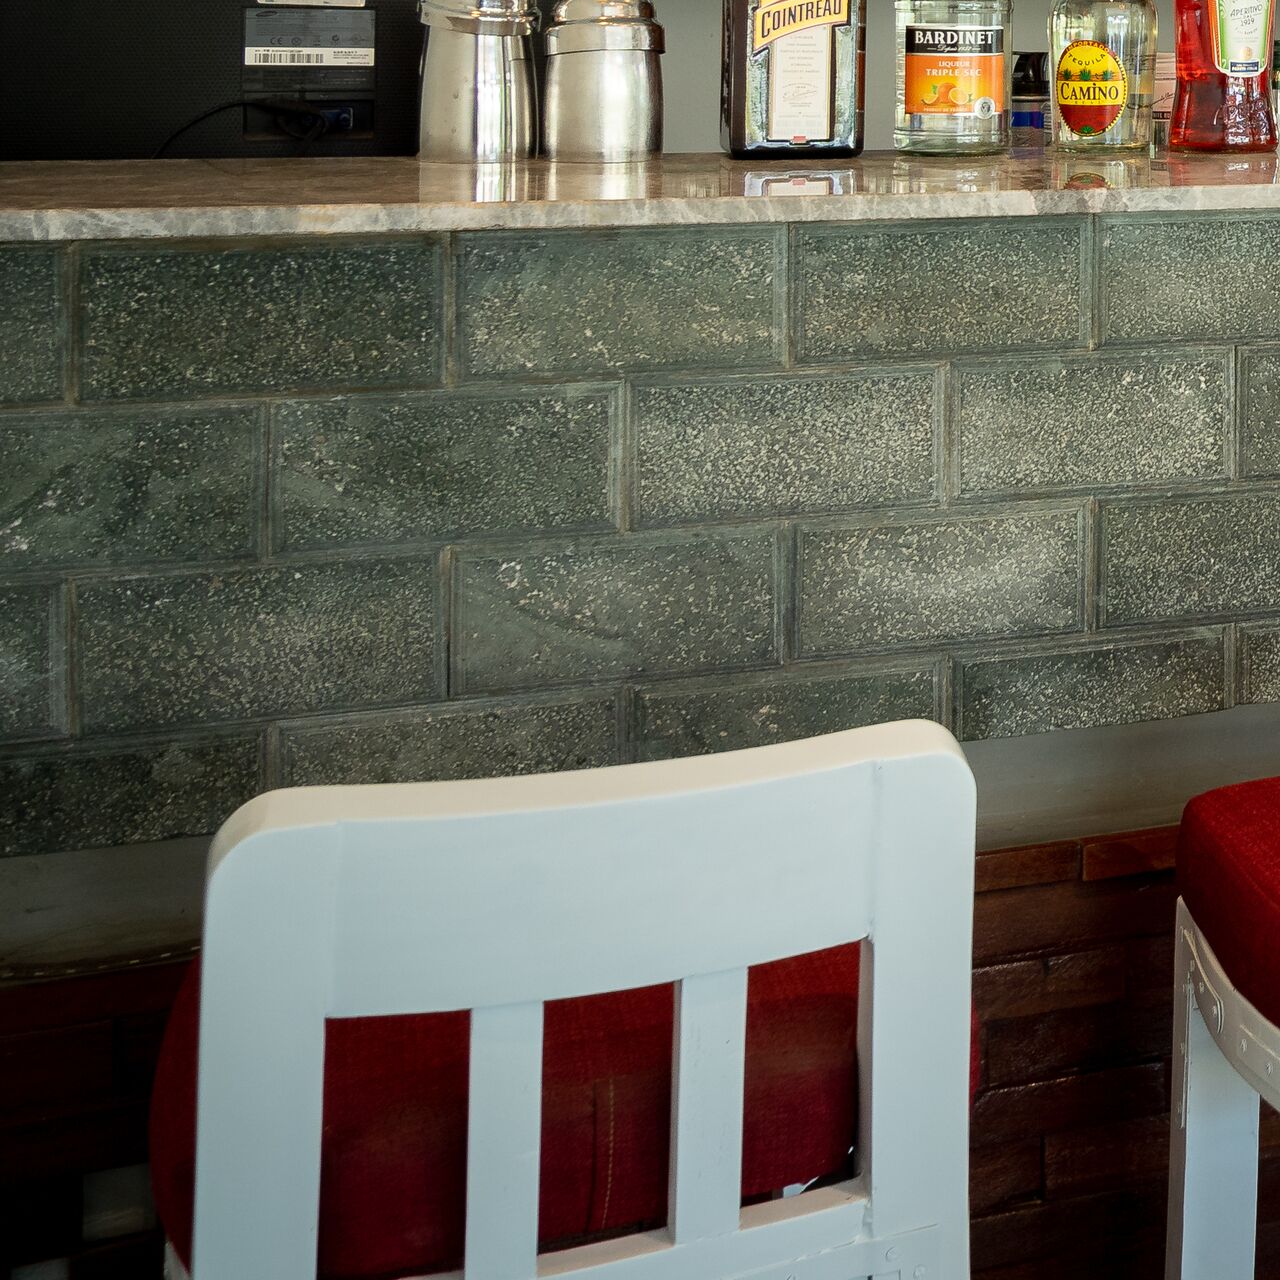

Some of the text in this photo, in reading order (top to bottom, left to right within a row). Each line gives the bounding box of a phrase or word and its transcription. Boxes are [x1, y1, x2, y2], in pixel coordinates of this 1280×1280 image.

[915, 30, 993, 45] BARDINET
[1068, 52, 1106, 66] TEQUILA
[926, 68, 982, 76] TRIPLE SEC
